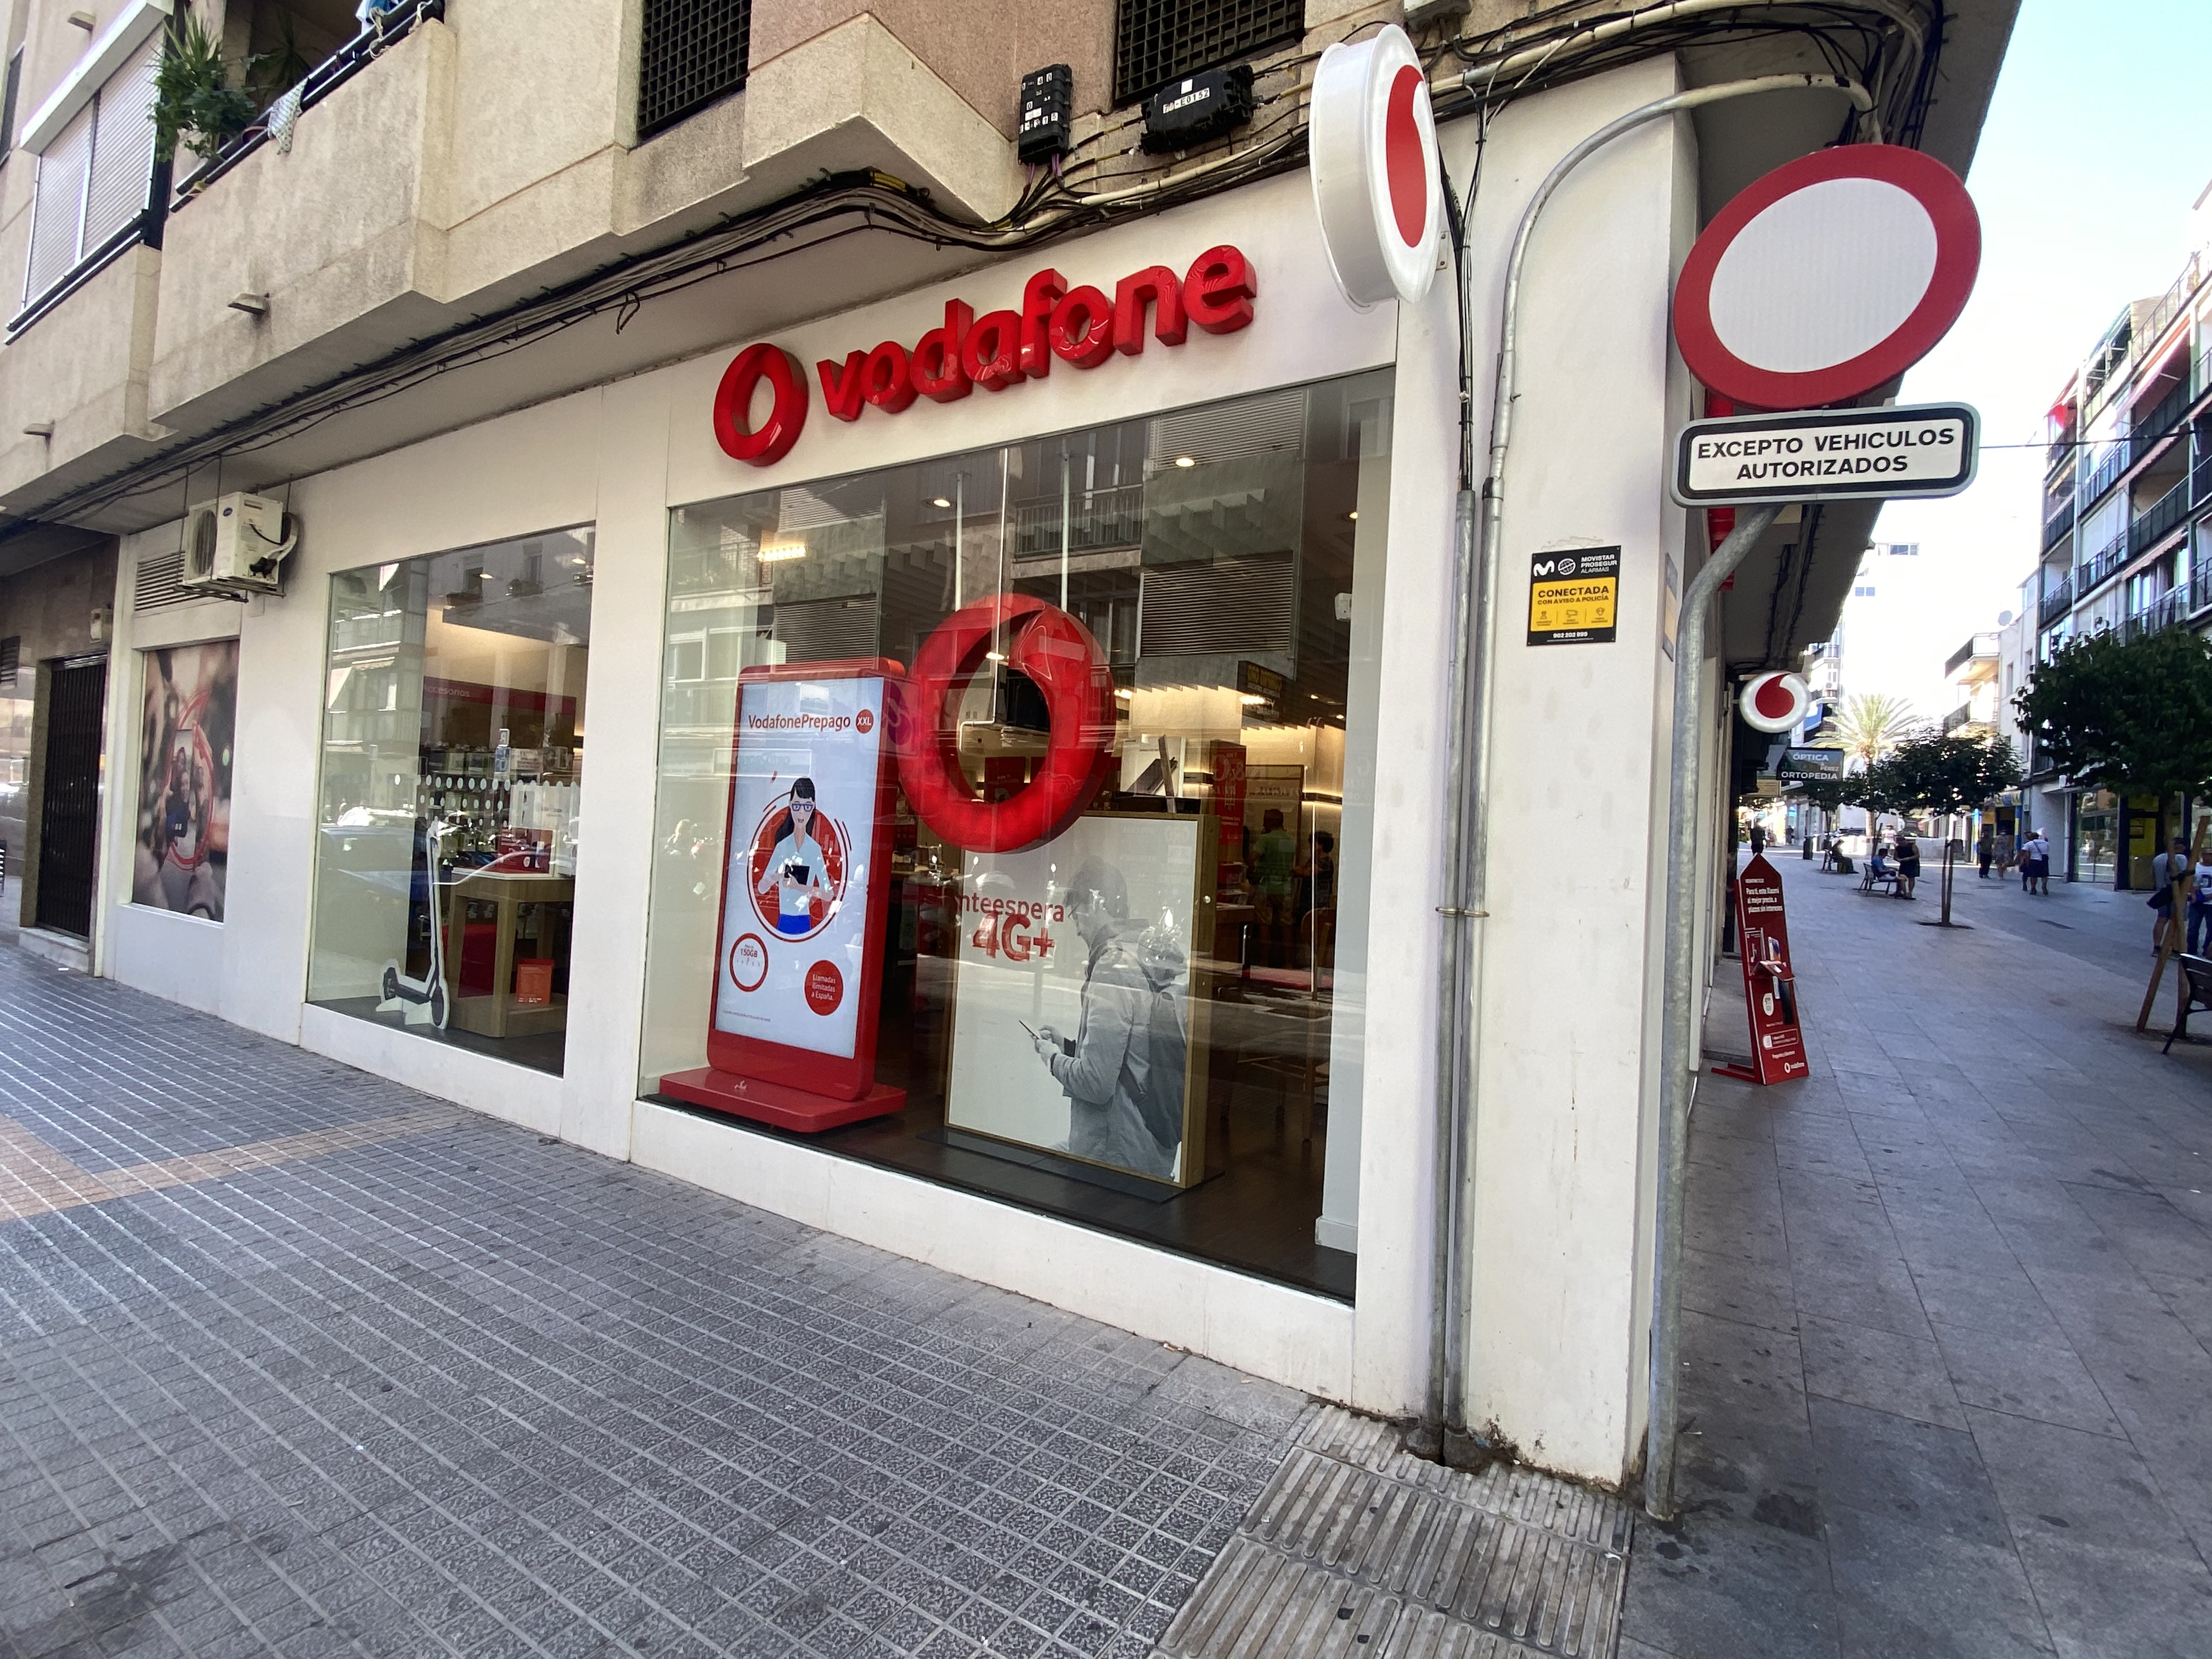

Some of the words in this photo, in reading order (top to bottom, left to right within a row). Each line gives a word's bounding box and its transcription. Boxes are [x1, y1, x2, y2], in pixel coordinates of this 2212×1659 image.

[816, 244, 1257, 422] vodafone
[1698, 437, 1803, 459] EXCEPTO
[1815, 427, 1954, 453] VEHICULOS
[1737, 455, 1908, 480] AUTORIZADOS
[1581, 554, 1615, 562] MOVISTAR
[1581, 560, 1617, 568] PROSEGUR
[1538, 585, 1610, 598] CONECTADA
[748, 714, 851, 732] VodafonePrepago
[857, 717, 872, 726] XXL
[1792, 752, 1829, 761] ÓPTICA
[1781, 771, 1838, 780] ORTOPEDIA
[972, 910, 1055, 962] 4G+
[812, 974, 836, 984] Llamadas
